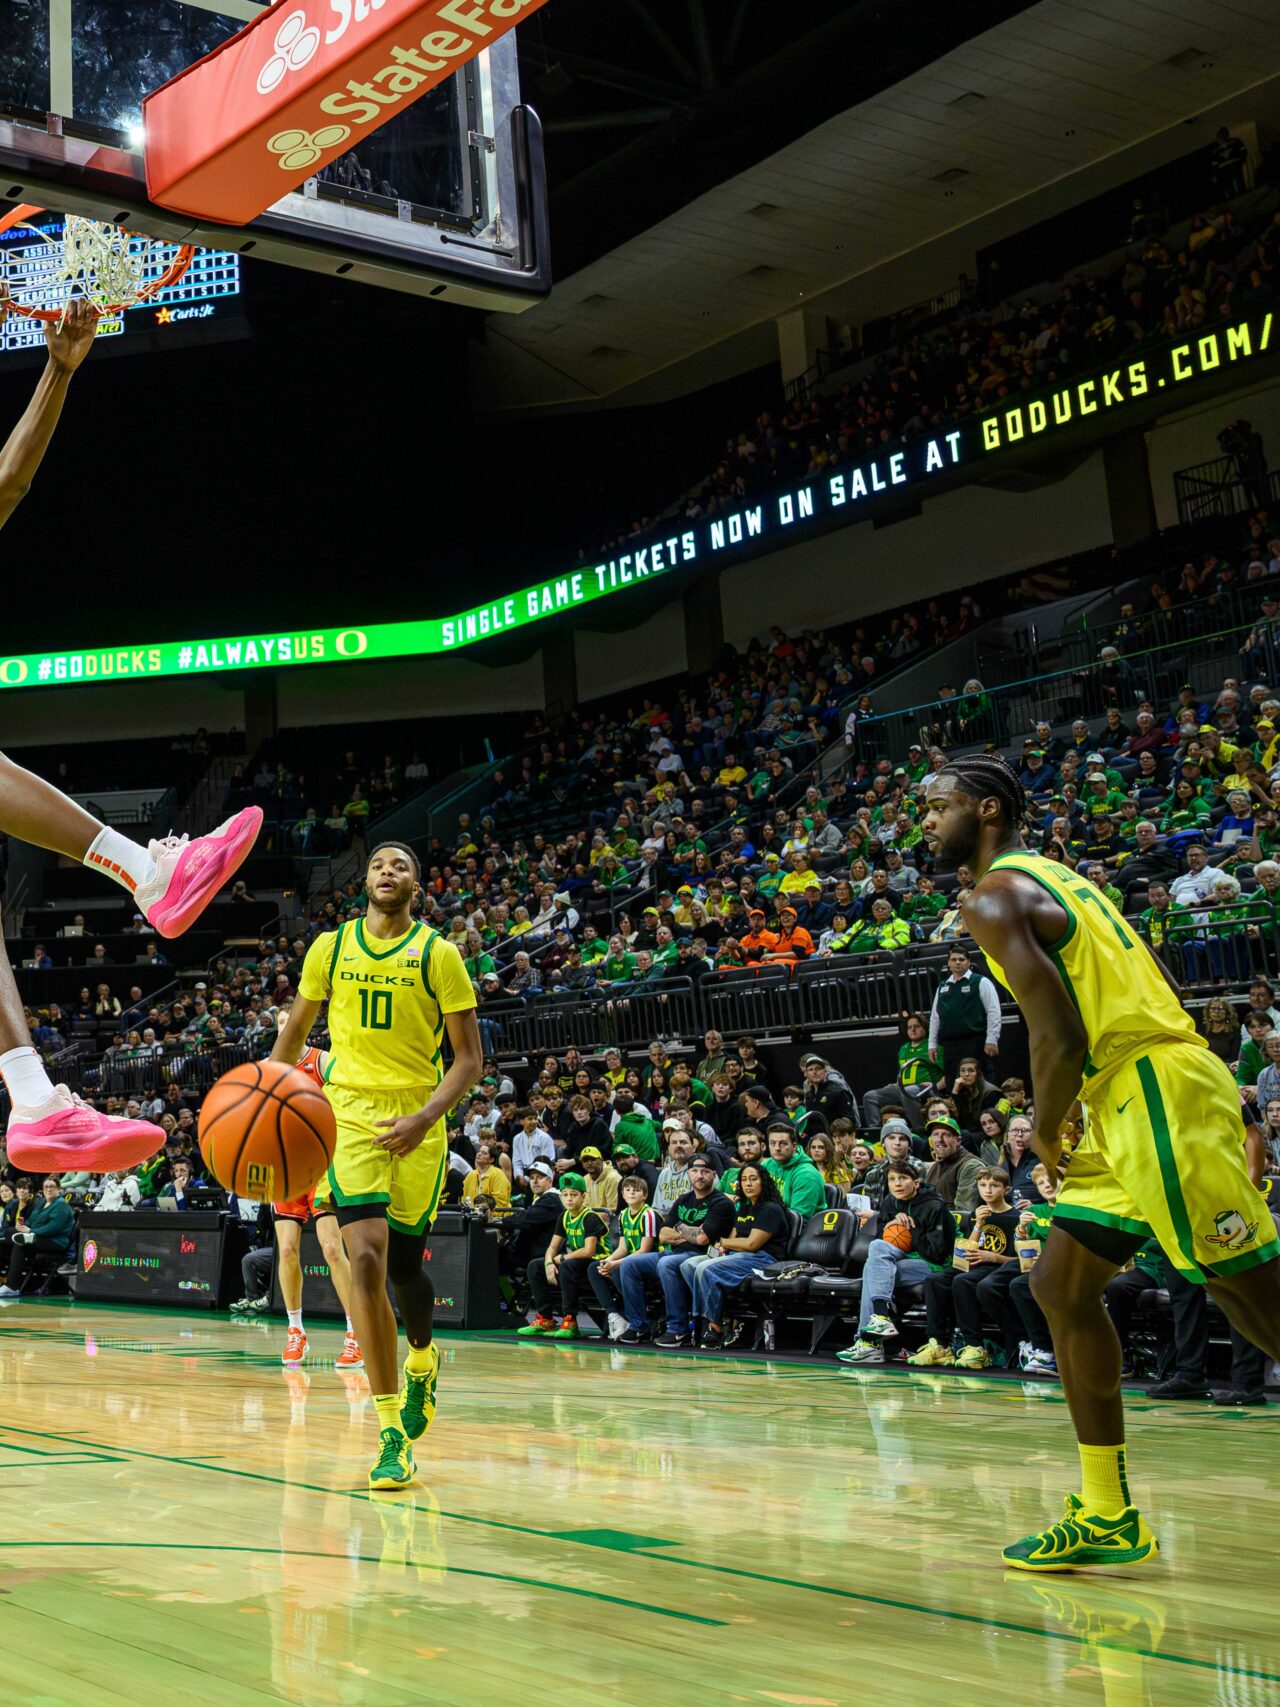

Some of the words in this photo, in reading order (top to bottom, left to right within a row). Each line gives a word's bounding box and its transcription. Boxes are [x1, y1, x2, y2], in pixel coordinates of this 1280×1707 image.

[442, 600, 514, 646] SINGLE
[527, 574, 584, 617] GAME
[595, 532, 696, 591] TICKETS
[710, 506, 762, 550] NOW
[779, 488, 814, 525] ON
[830, 452, 907, 506] SALE
[926, 432, 962, 472] AT
[982, 313, 1273, 450] GODUCKS.COM/
[1072, 887, 1134, 950] 7
[340, 971, 415, 987] DUCKS
[358, 988, 392, 1030] 10
